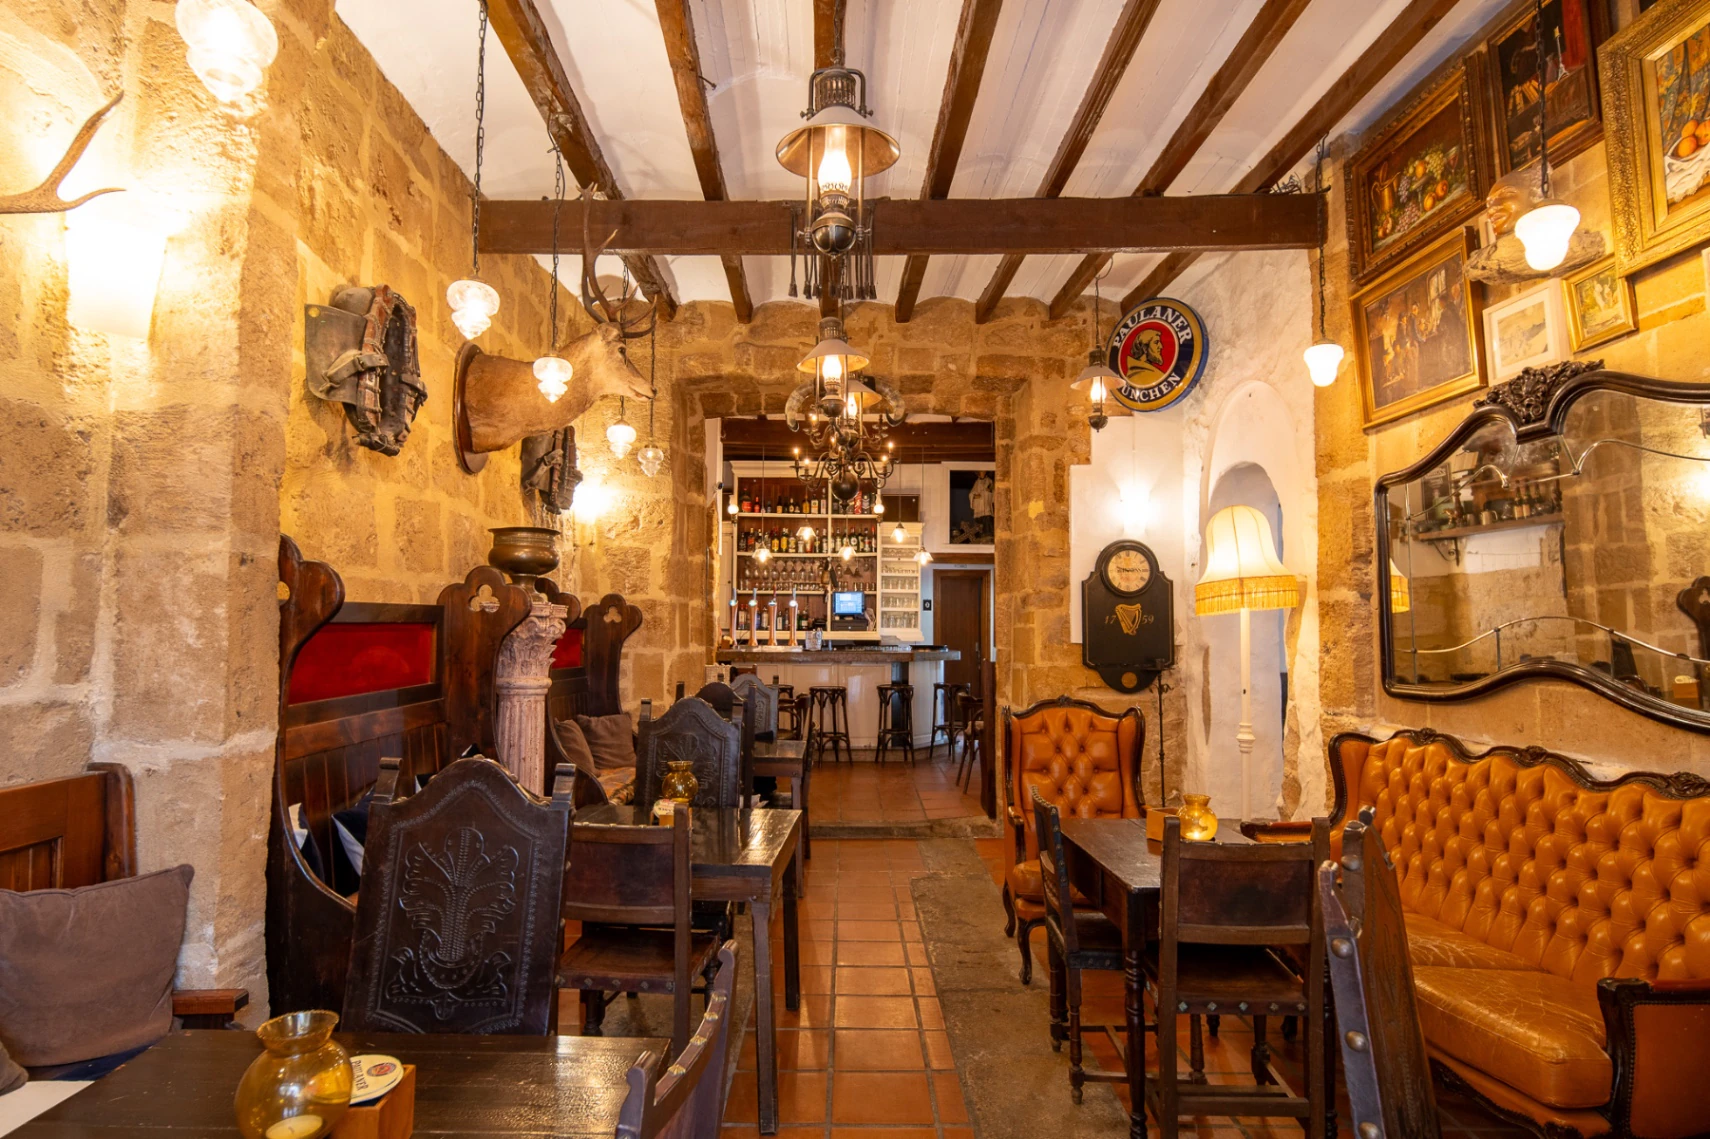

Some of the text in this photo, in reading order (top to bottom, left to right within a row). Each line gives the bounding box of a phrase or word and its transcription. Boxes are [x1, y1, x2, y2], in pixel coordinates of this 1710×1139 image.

[1113, 306, 1192, 348] PAULANER
[1105, 615, 1154, 625] 17 59
